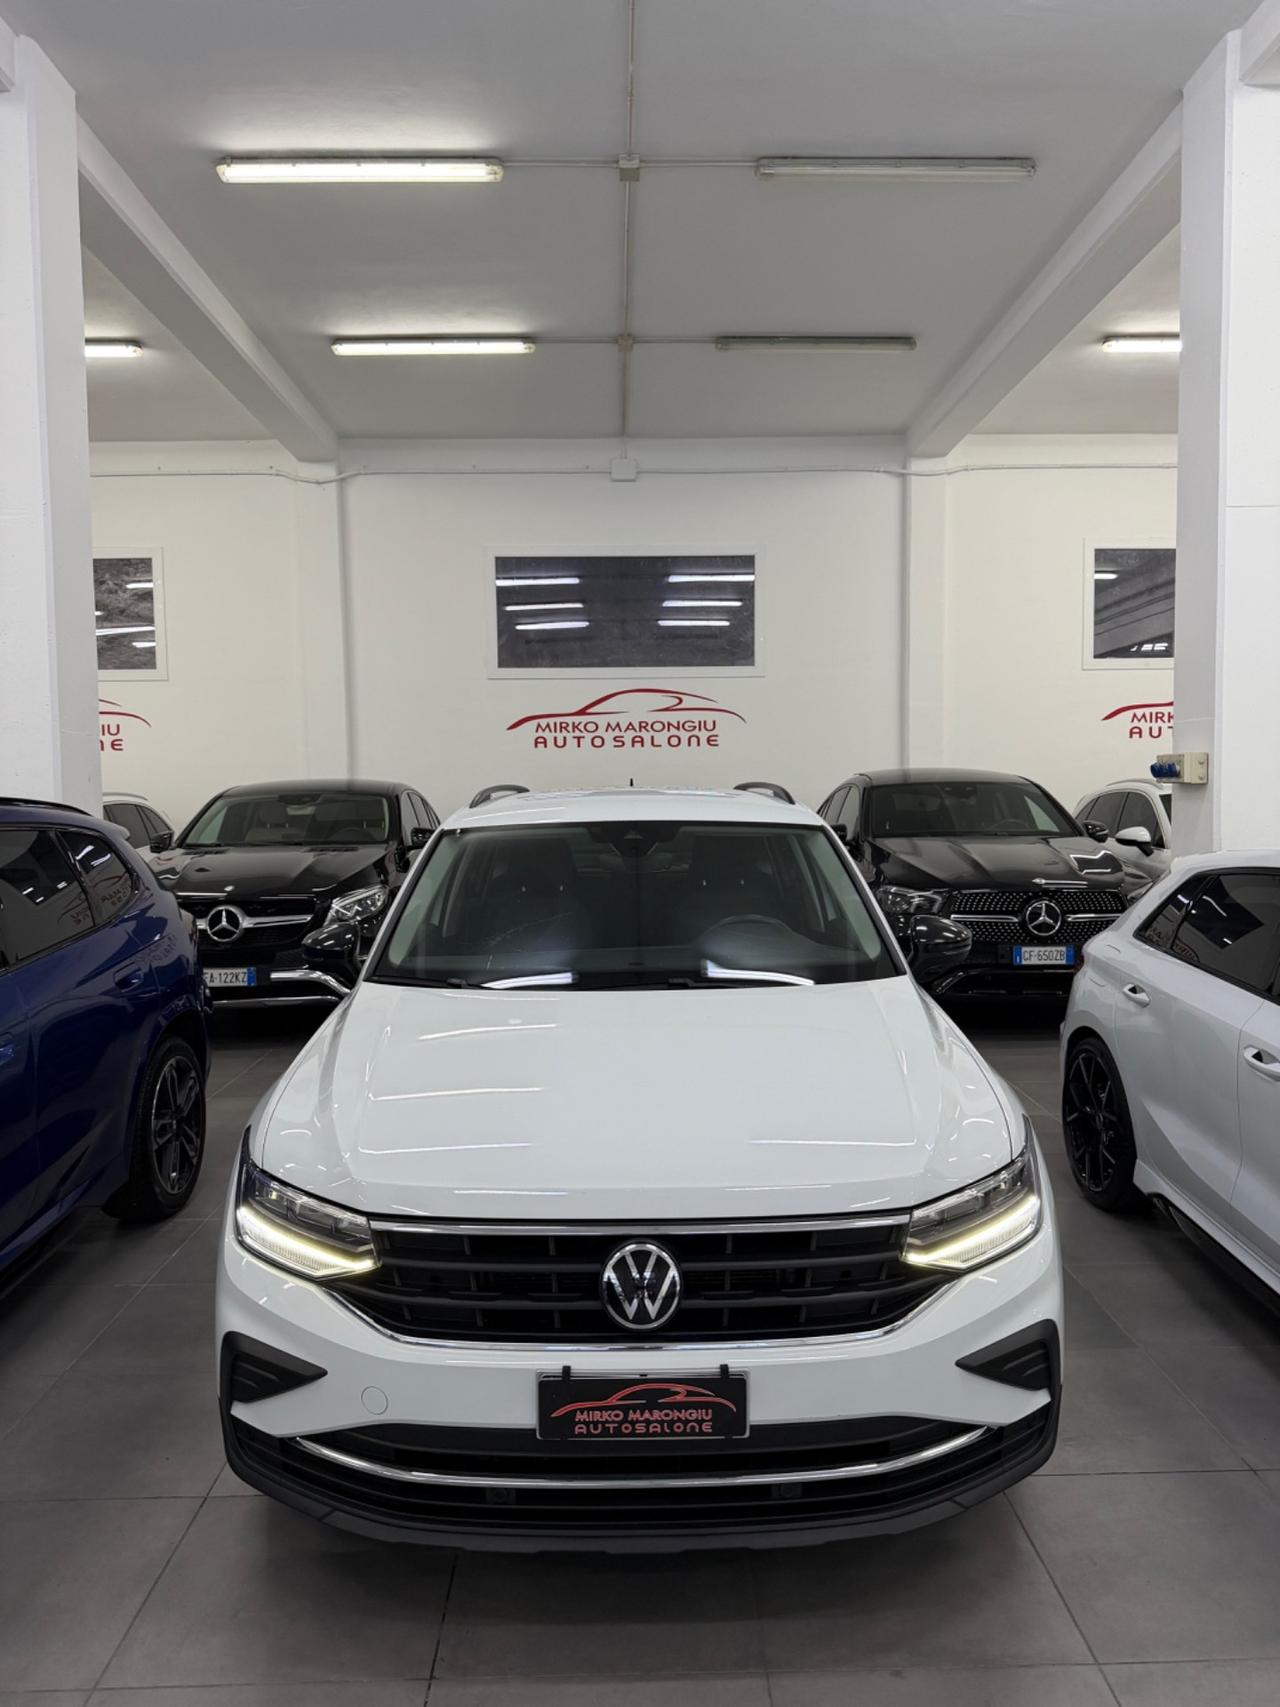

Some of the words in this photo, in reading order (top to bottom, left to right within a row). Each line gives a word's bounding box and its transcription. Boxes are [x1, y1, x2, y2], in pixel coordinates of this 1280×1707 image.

[1130, 711, 1174, 724] MIRK
[535, 720, 599, 734] MIRKO
[605, 719, 717, 733] MARONGIU
[533, 734, 720, 749] AUTOSALONE
[575, 1410, 624, 1422] MIRKO
[628, 1409, 713, 1421] MARONGIU
[574, 1422, 713, 1435] AUTOSALONE
